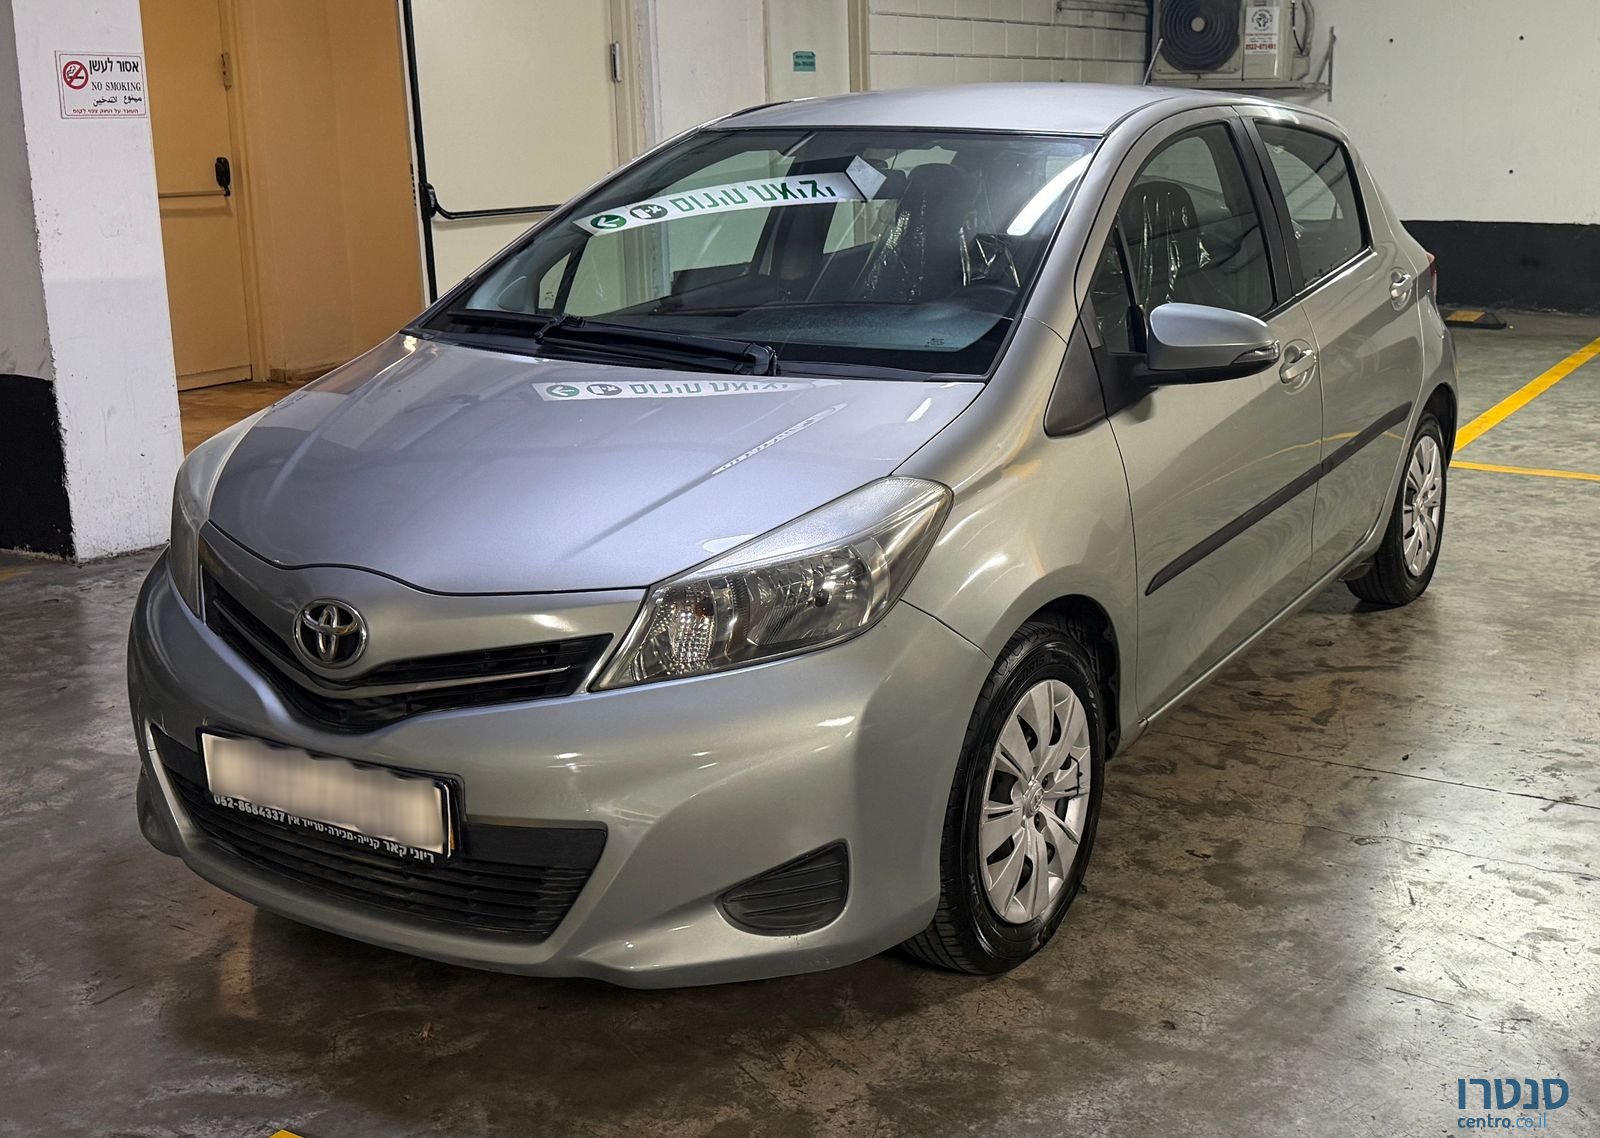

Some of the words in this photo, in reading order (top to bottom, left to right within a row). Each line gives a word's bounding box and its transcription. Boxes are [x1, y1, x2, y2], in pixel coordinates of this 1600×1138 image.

[89, 57, 113, 75] לעשן
[116, 60, 139, 73] אסור
[92, 81, 103, 91] NO
[105, 81, 141, 92] SMOKING
[383, 840, 408, 858] קאר
